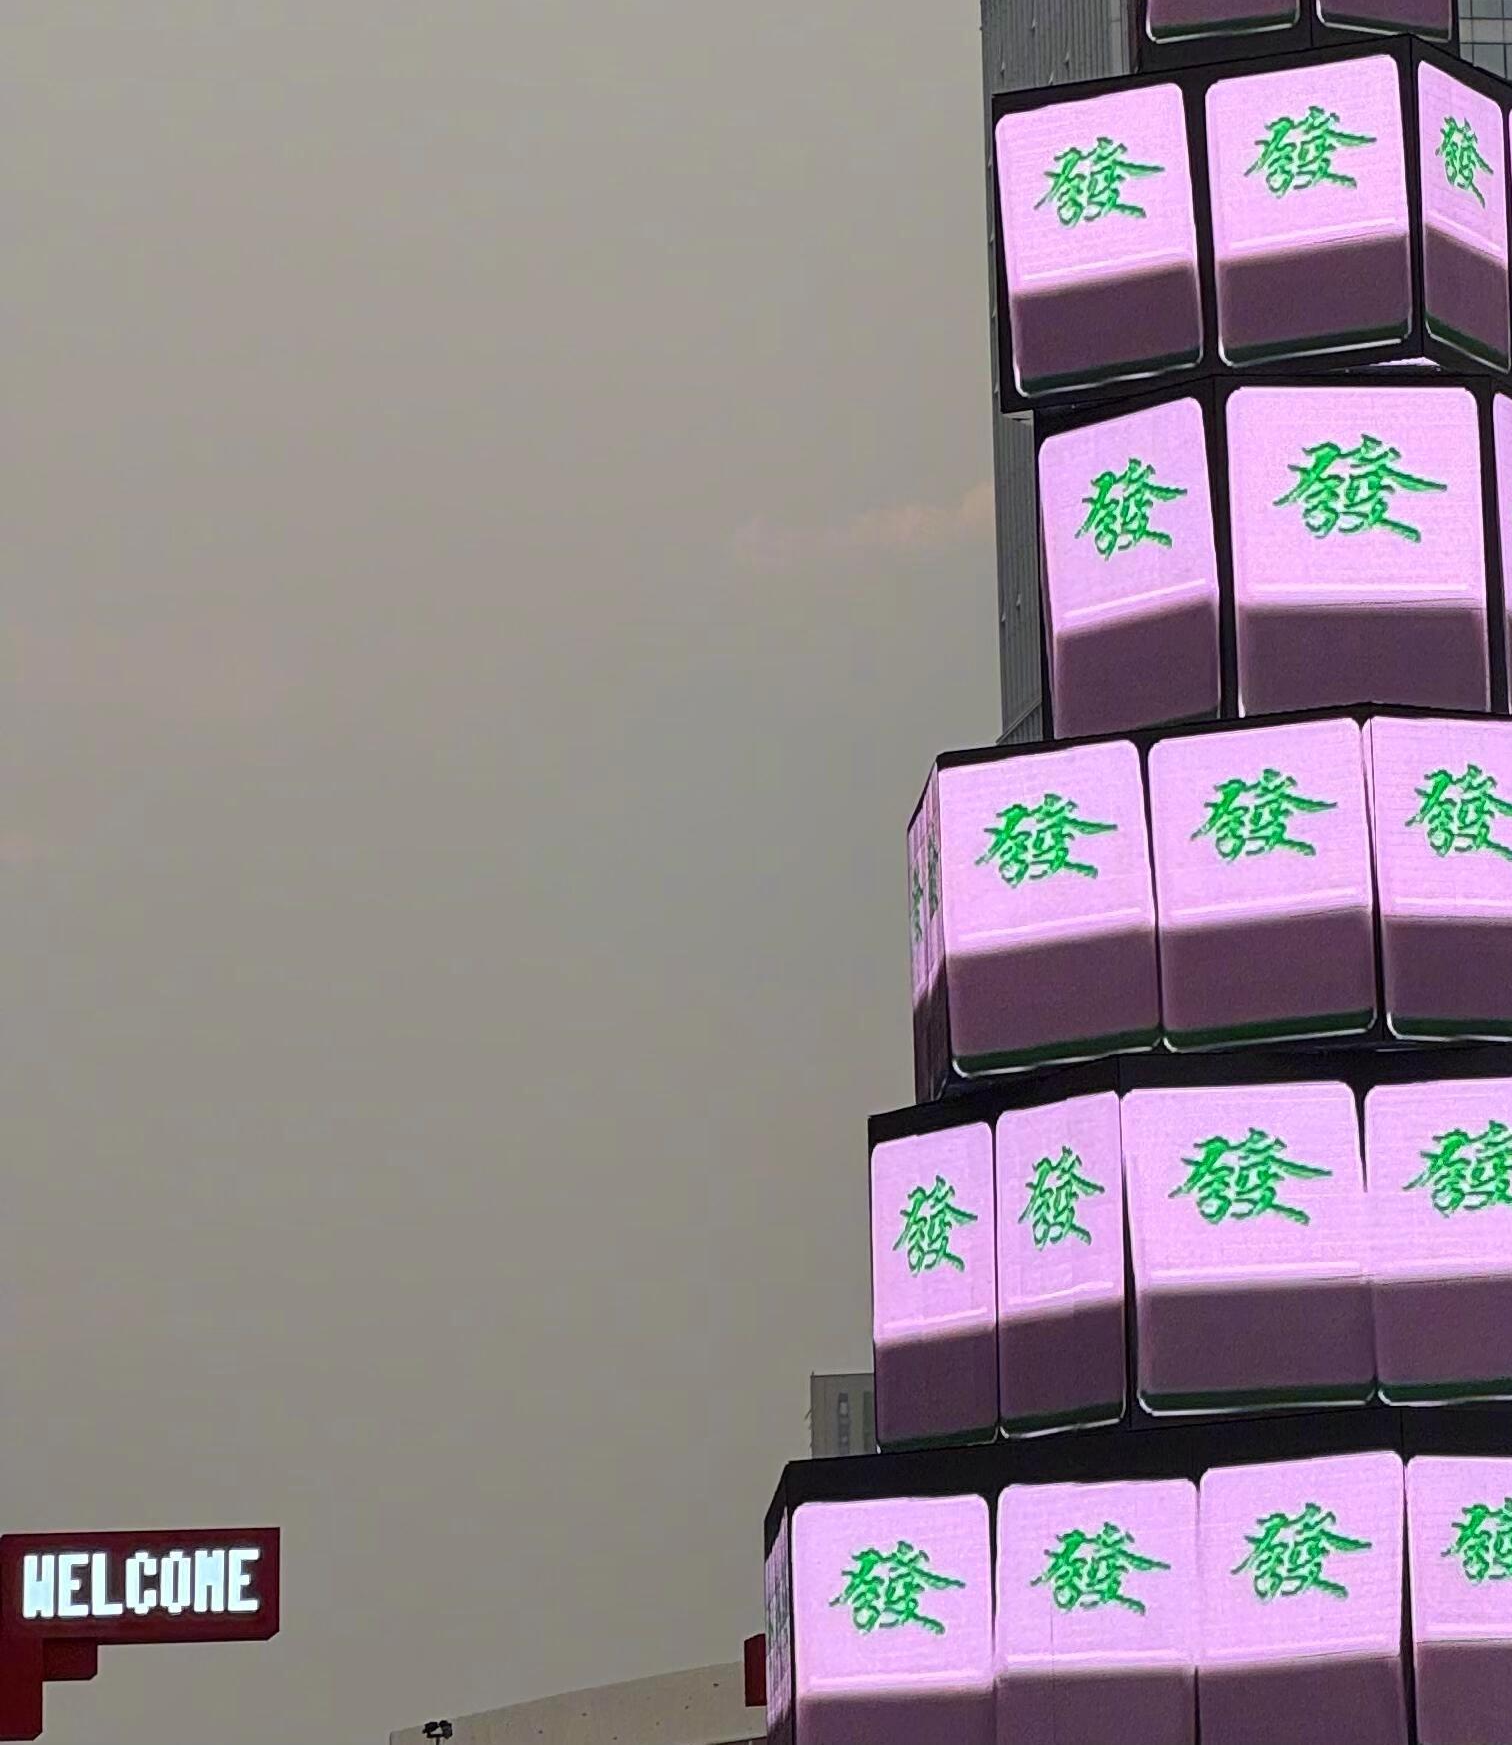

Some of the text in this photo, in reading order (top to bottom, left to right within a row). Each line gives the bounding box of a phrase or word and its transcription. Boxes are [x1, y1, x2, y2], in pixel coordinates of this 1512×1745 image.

[1039, 135, 1166, 229] 發
[1246, 104, 1376, 199] 發
[1074, 456, 1189, 561] 發
[1273, 433, 1449, 545] 發
[974, 790, 1119, 889] 發
[1191, 766, 1337, 865] 發
[893, 1174, 978, 1276] 發
[1018, 1145, 1106, 1251] 發
[1171, 1126, 1335, 1227] 發
[23, 1549, 260, 1618] WELCOME
[829, 1538, 968, 1637] 發
[1030, 1520, 1171, 1615] 發
[1233, 1501, 1374, 1604] 發
